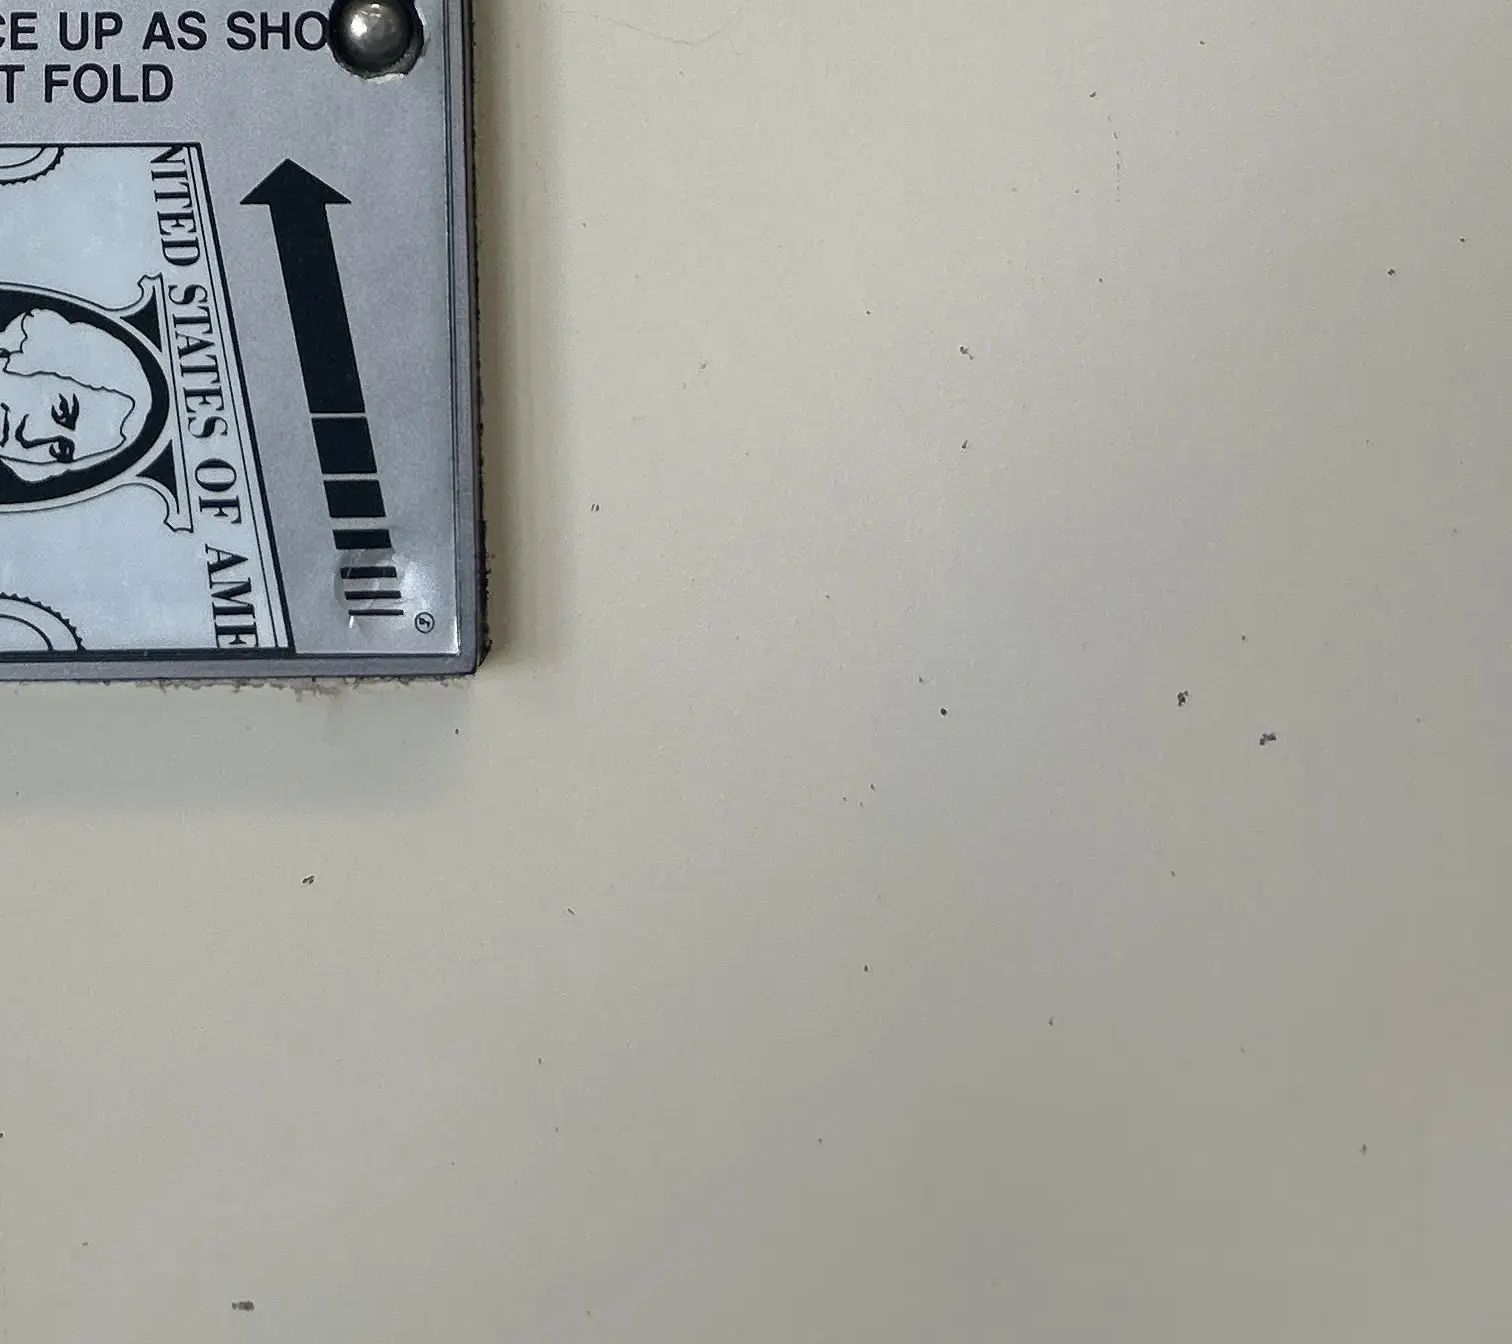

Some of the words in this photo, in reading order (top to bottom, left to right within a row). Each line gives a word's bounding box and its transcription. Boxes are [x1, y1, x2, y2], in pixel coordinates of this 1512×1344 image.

[59, 11, 124, 52] UP
[141, 10, 208, 51] AS
[44, 62, 174, 104] FOLD
[167, 282, 229, 440] STATES
[193, 457, 243, 525] OF
